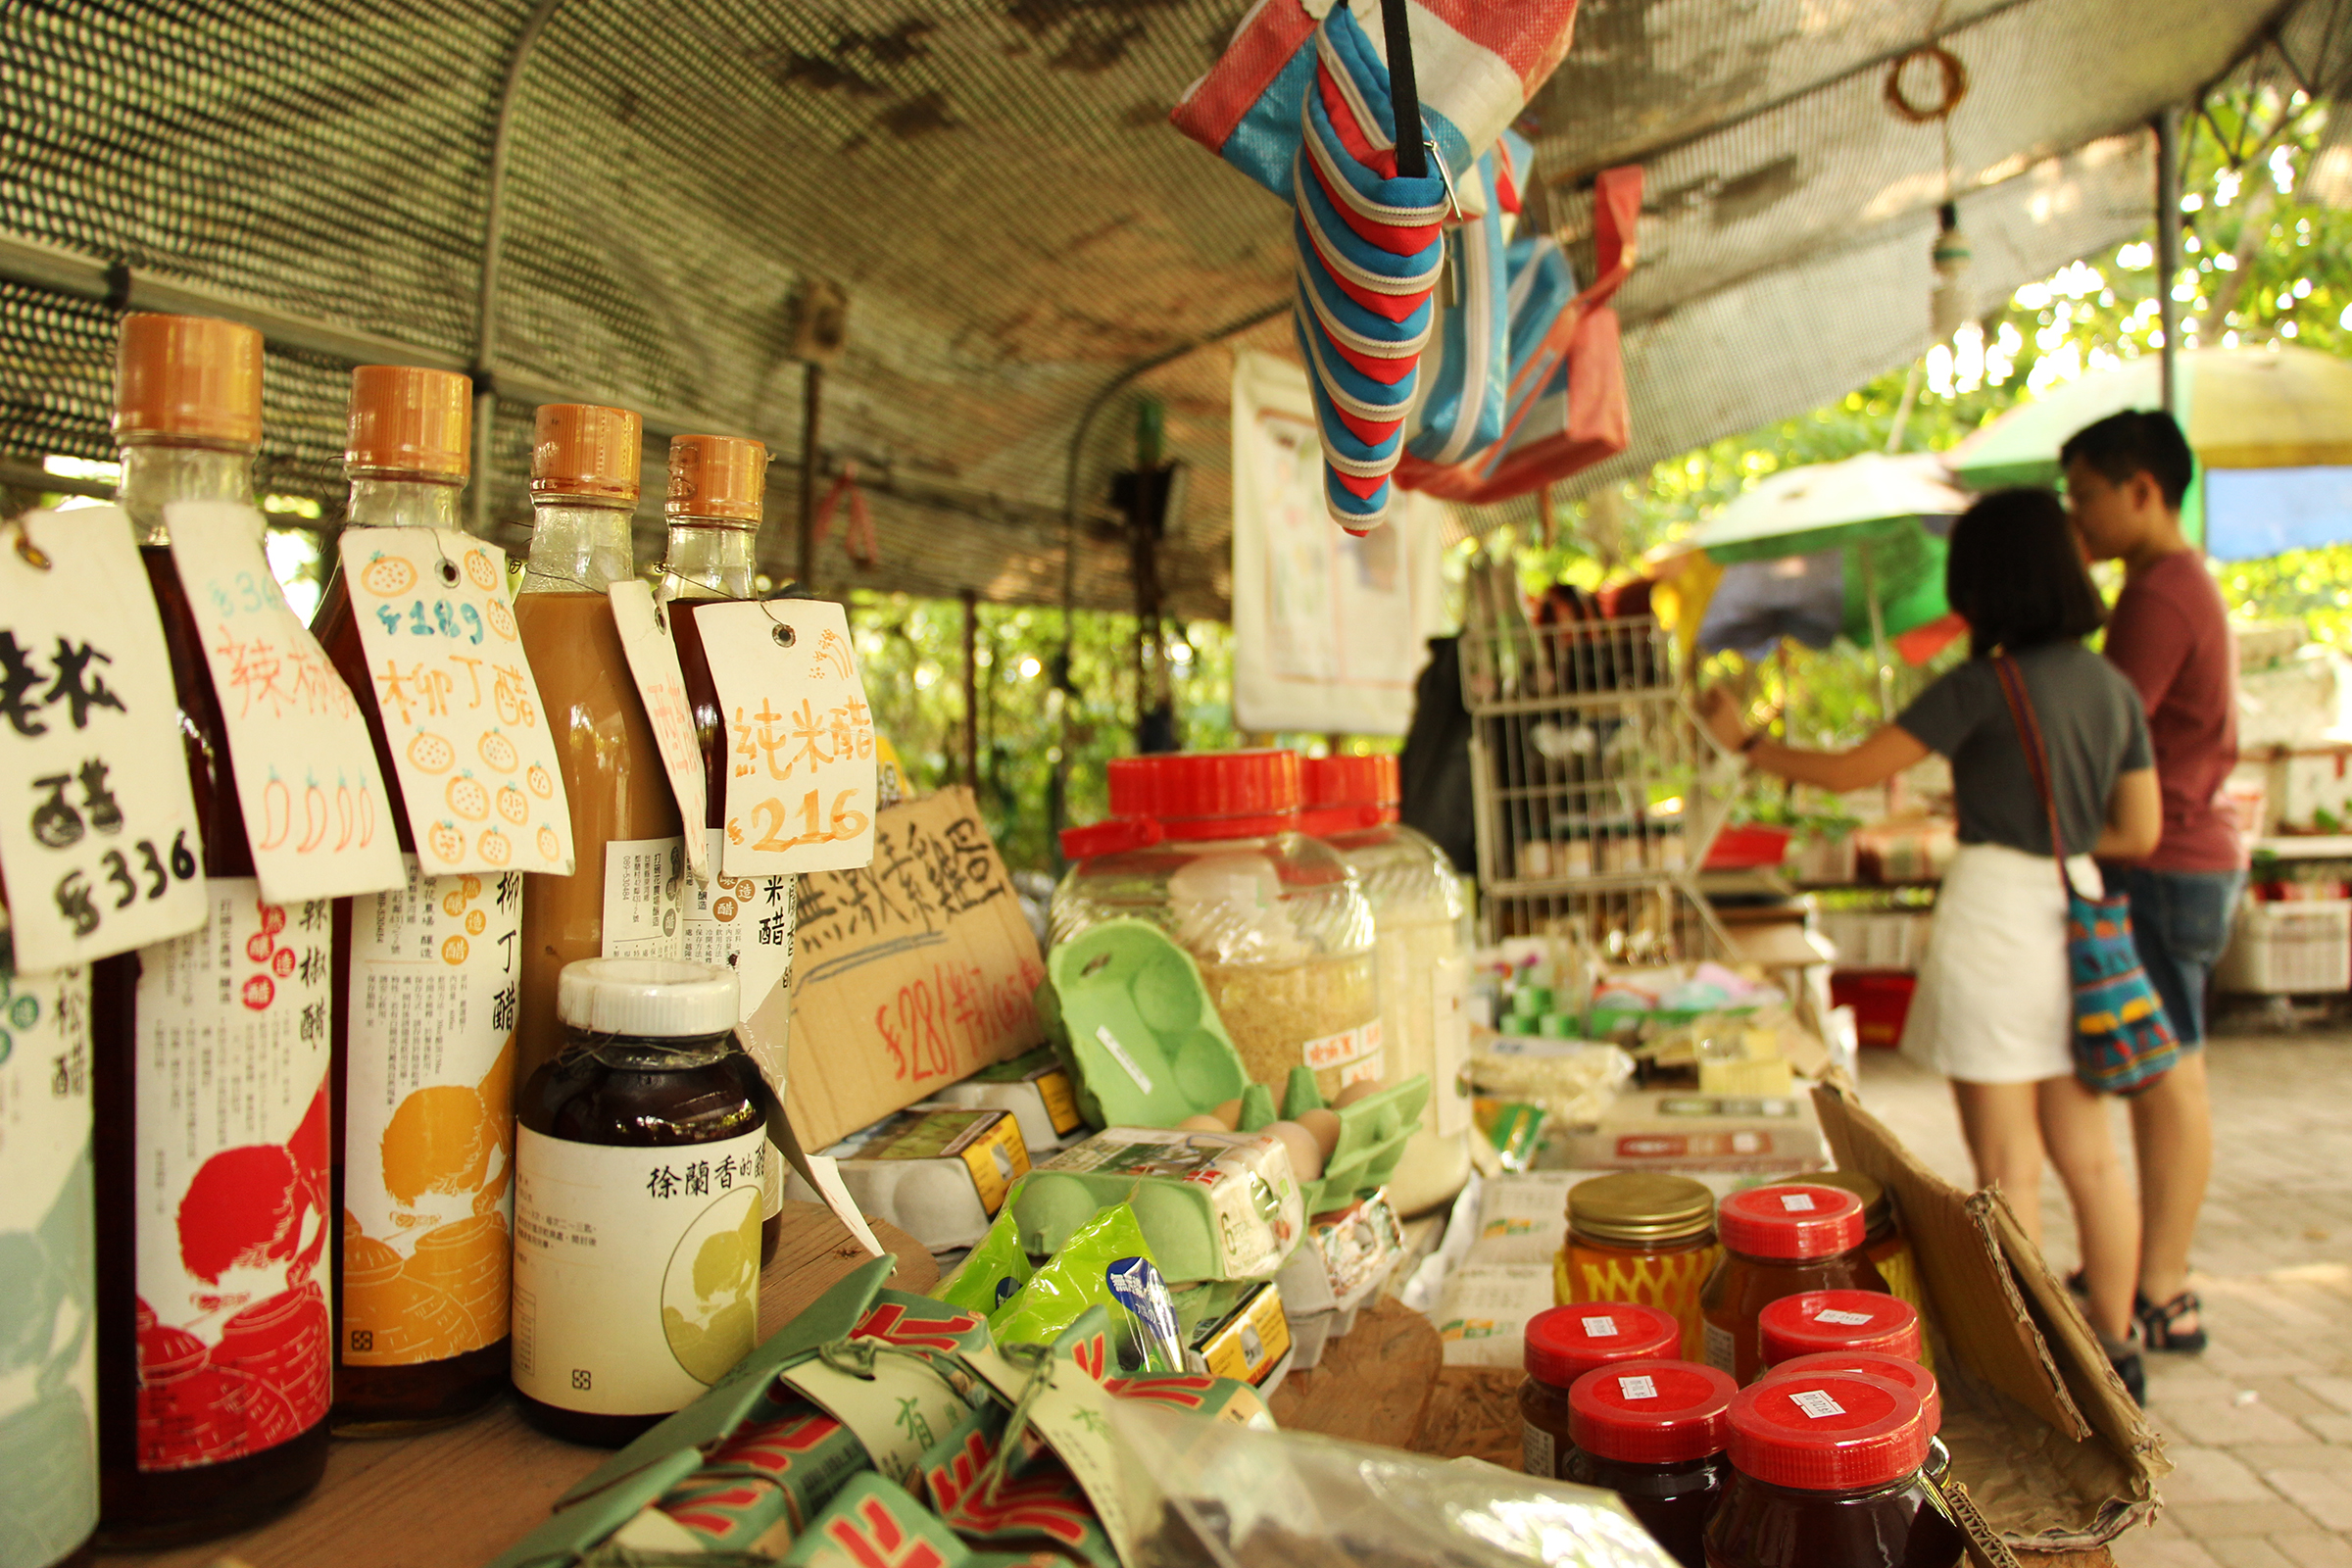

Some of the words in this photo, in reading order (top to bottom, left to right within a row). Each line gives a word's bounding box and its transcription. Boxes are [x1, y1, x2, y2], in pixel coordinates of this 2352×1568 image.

[375, 599, 484, 646] $189
[375, 654, 536, 728] 柳丁醋
[734, 694, 874, 782] 純米醋
[727, 787, 870, 854] $216
[54, 827, 197, 939] $336
[491, 871, 521, 1034] 柳丁醋
